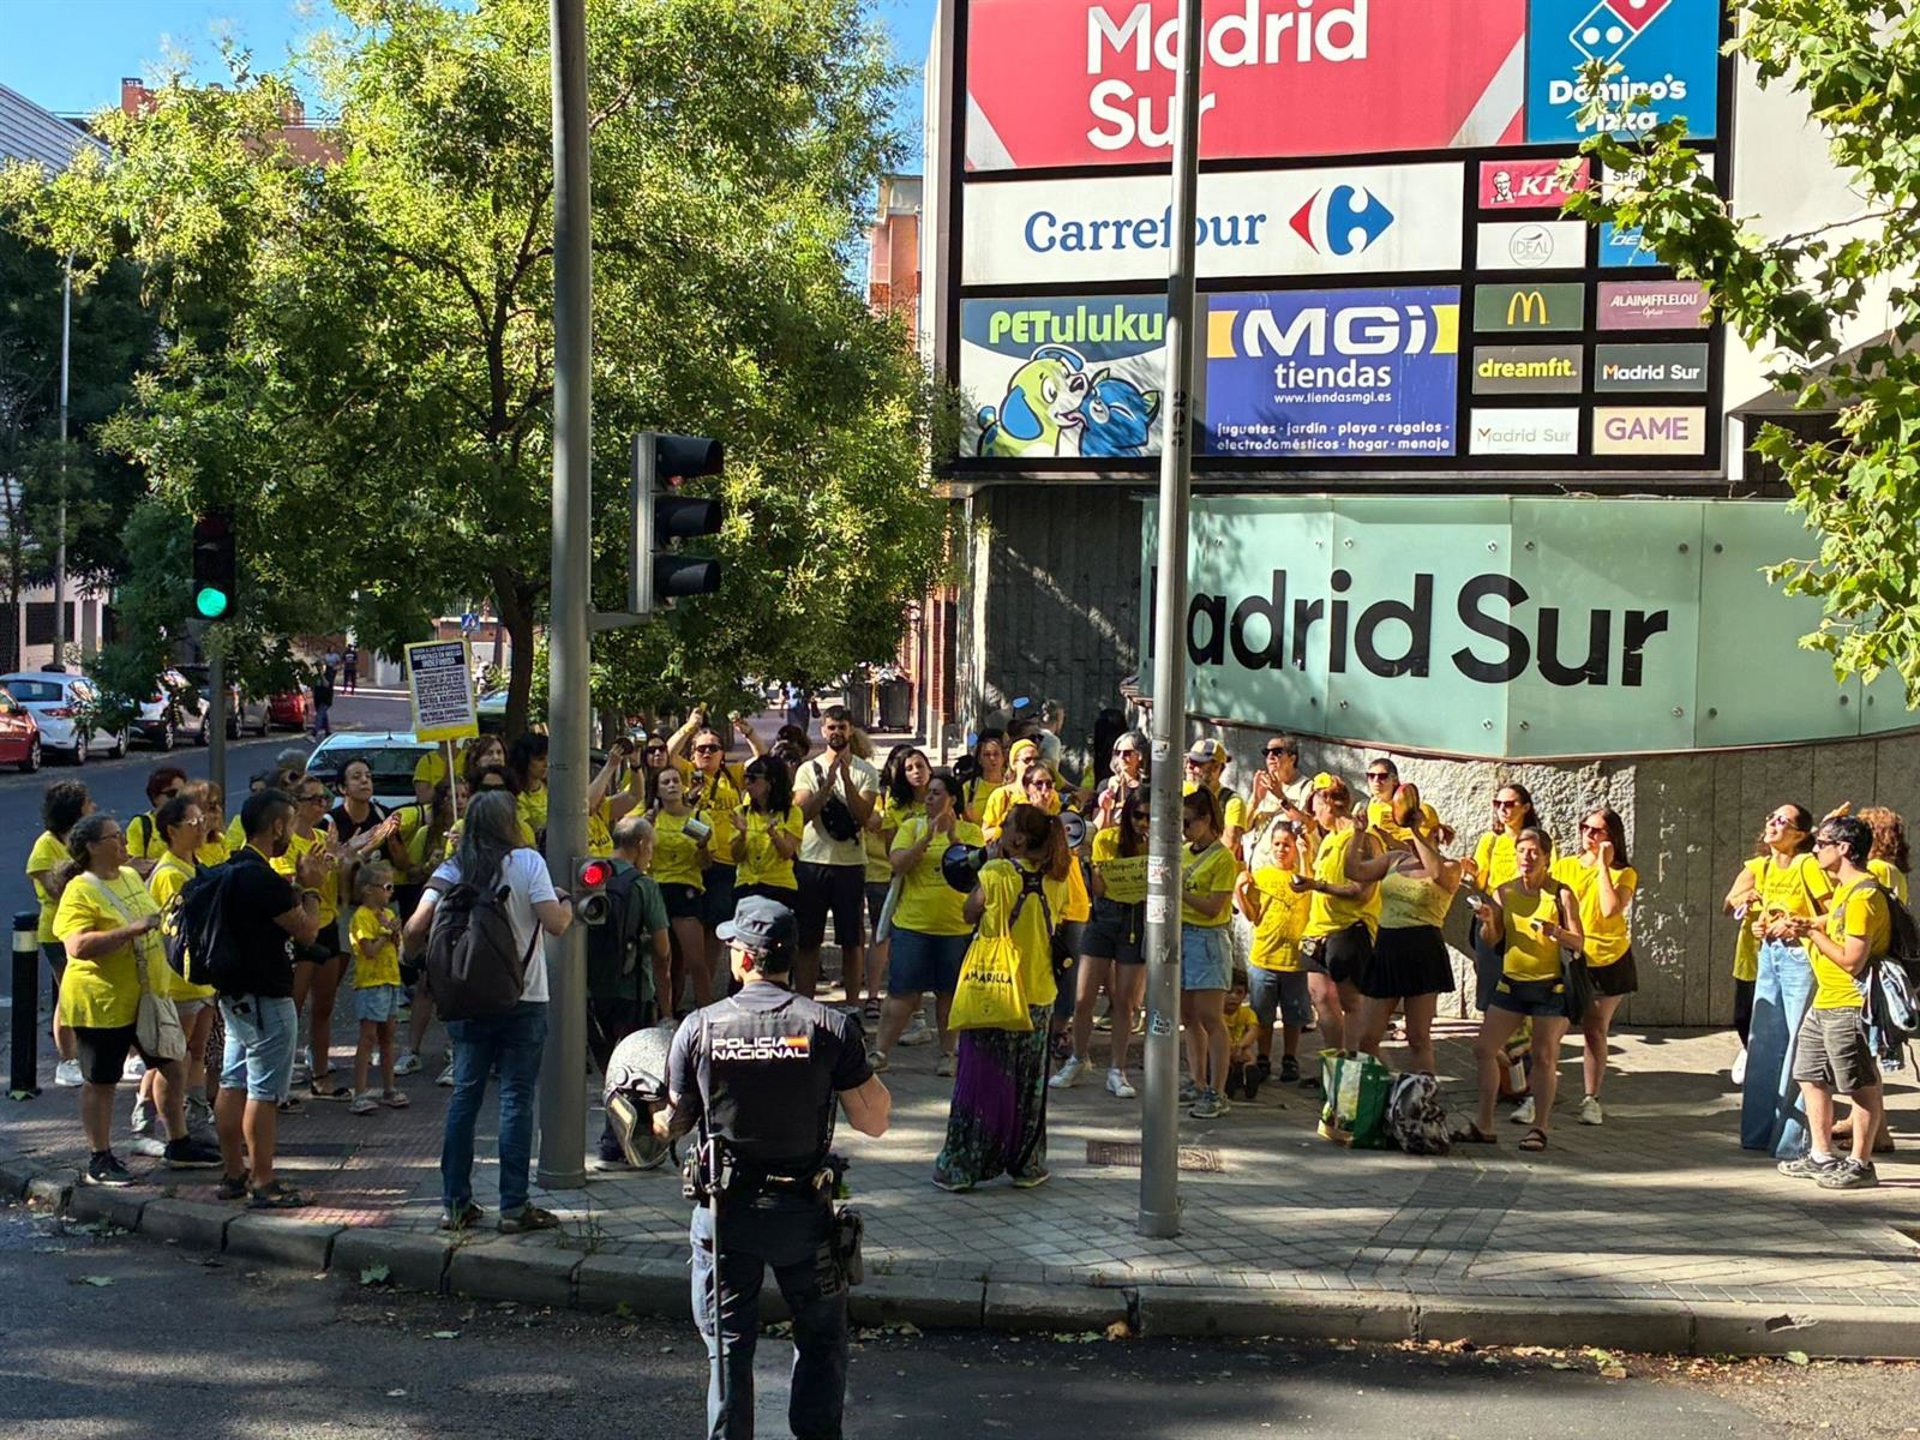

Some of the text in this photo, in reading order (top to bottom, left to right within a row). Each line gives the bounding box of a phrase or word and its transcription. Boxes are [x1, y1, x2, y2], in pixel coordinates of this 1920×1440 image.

[1576, 111, 1660, 133] izza
[1274, 359, 1392, 389] tiendas
[1603, 364, 1701, 382] Madrid Sur
[1274, 392, 1392, 405] www.tiendasmgi.es
[1217, 420, 1442, 437] juguetes jardín playa regalos
[1477, 427, 1572, 445] Madrid Sur
[1605, 417, 1689, 441] GAME
[1217, 437, 1450, 451] electrodomésticos hogar menaje
[1149, 566, 1669, 687] adrid Sur
[963, 971, 1013, 986] AMARILLA
[712, 1036, 788, 1048] POLICIA
[712, 1047, 809, 1061] NACIONAL
